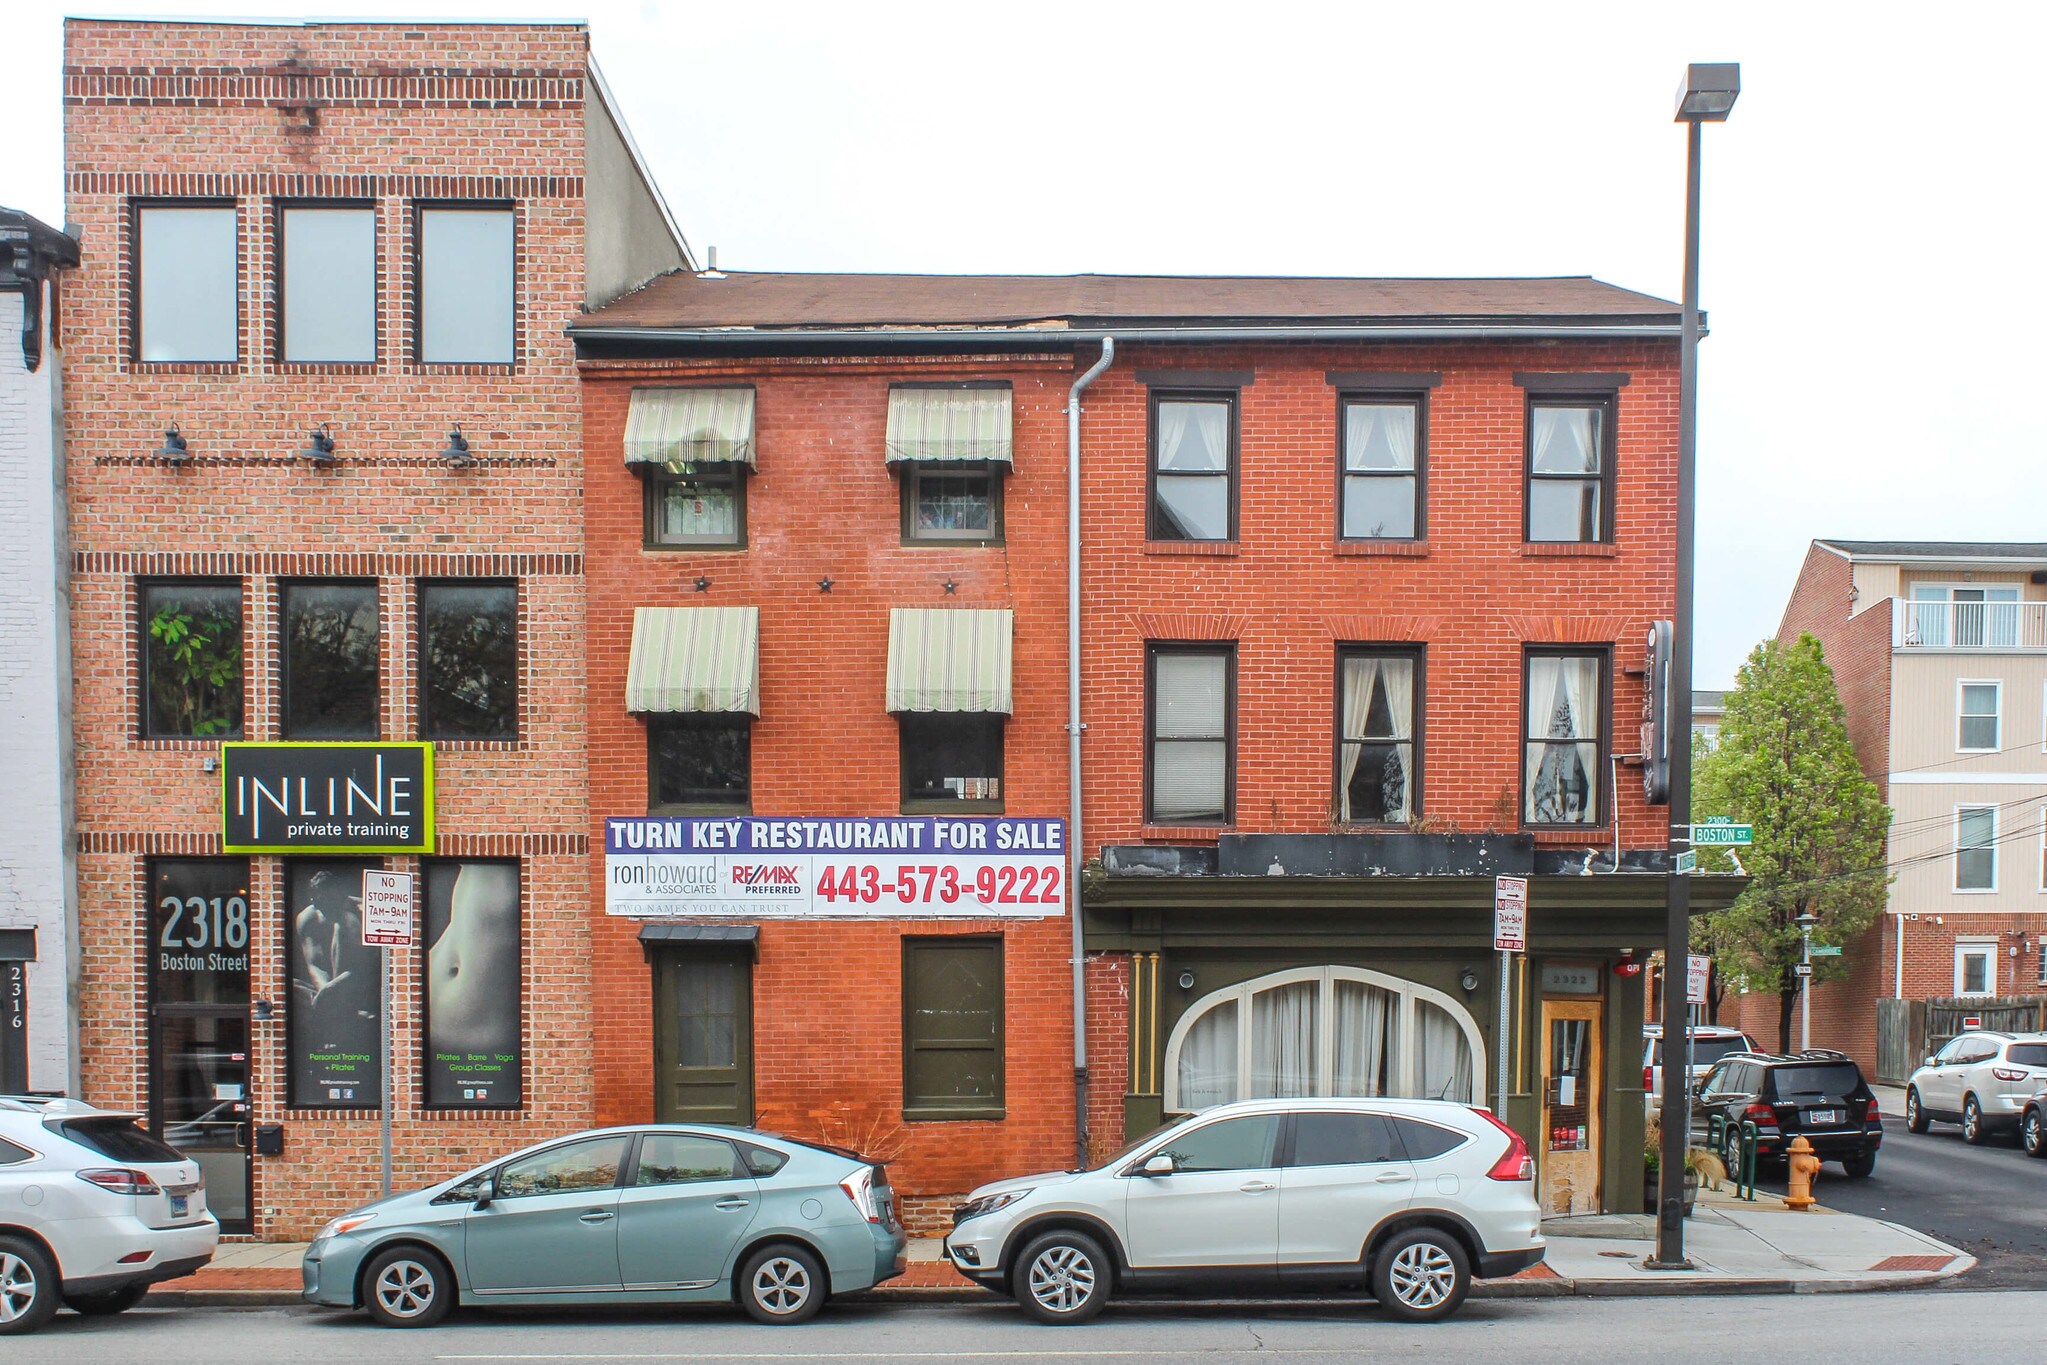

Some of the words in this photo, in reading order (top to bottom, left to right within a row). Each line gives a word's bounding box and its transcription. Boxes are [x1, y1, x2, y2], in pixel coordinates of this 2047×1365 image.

[238, 754, 411, 839] INLINE
[288, 822, 342, 839] private
[348, 822, 410, 839] training
[610, 822, 682, 849] TURN
[693, 822, 742, 848] KEY
[752, 822, 925, 849] RESTAURANT
[934, 822, 987, 849] FOR
[996, 823, 1061, 849] SALE
[1696, 828, 1735, 841] BOSTON
[381, 877, 396, 888] NO
[816, 865, 1061, 904] 443-573-9222
[1506, 881, 1524, 891] STOPPING
[645, 885, 652, 894] &
[655, 885, 717, 894] ASSOCIATES
[745, 885, 801, 894] PREFERRED
[368, 891, 409, 904] STOPPING
[369, 905, 408, 917] 7AM-9AM
[614, 904, 642, 913] TWO
[647, 904, 687, 913] NAMES
[692, 904, 717, 913] YOU
[721, 904, 746, 913] CAN
[751, 904, 789, 913] TRUST
[1505, 901, 1524, 911] STOPPING
[161, 896, 248, 948] 2318
[161, 953, 205, 971] Boston
[208, 953, 248, 971] Street
[11, 966, 23, 1028] 2316
[341, 1053, 370, 1062] Training
[436, 1053, 460, 1061] Pilates
[467, 1053, 487, 1061] Barre
[494, 1053, 514, 1062] Yoga
[331, 1063, 355, 1071] Pilates
[449, 1063, 473, 1071] Group
[474, 1063, 501, 1071] Classes
